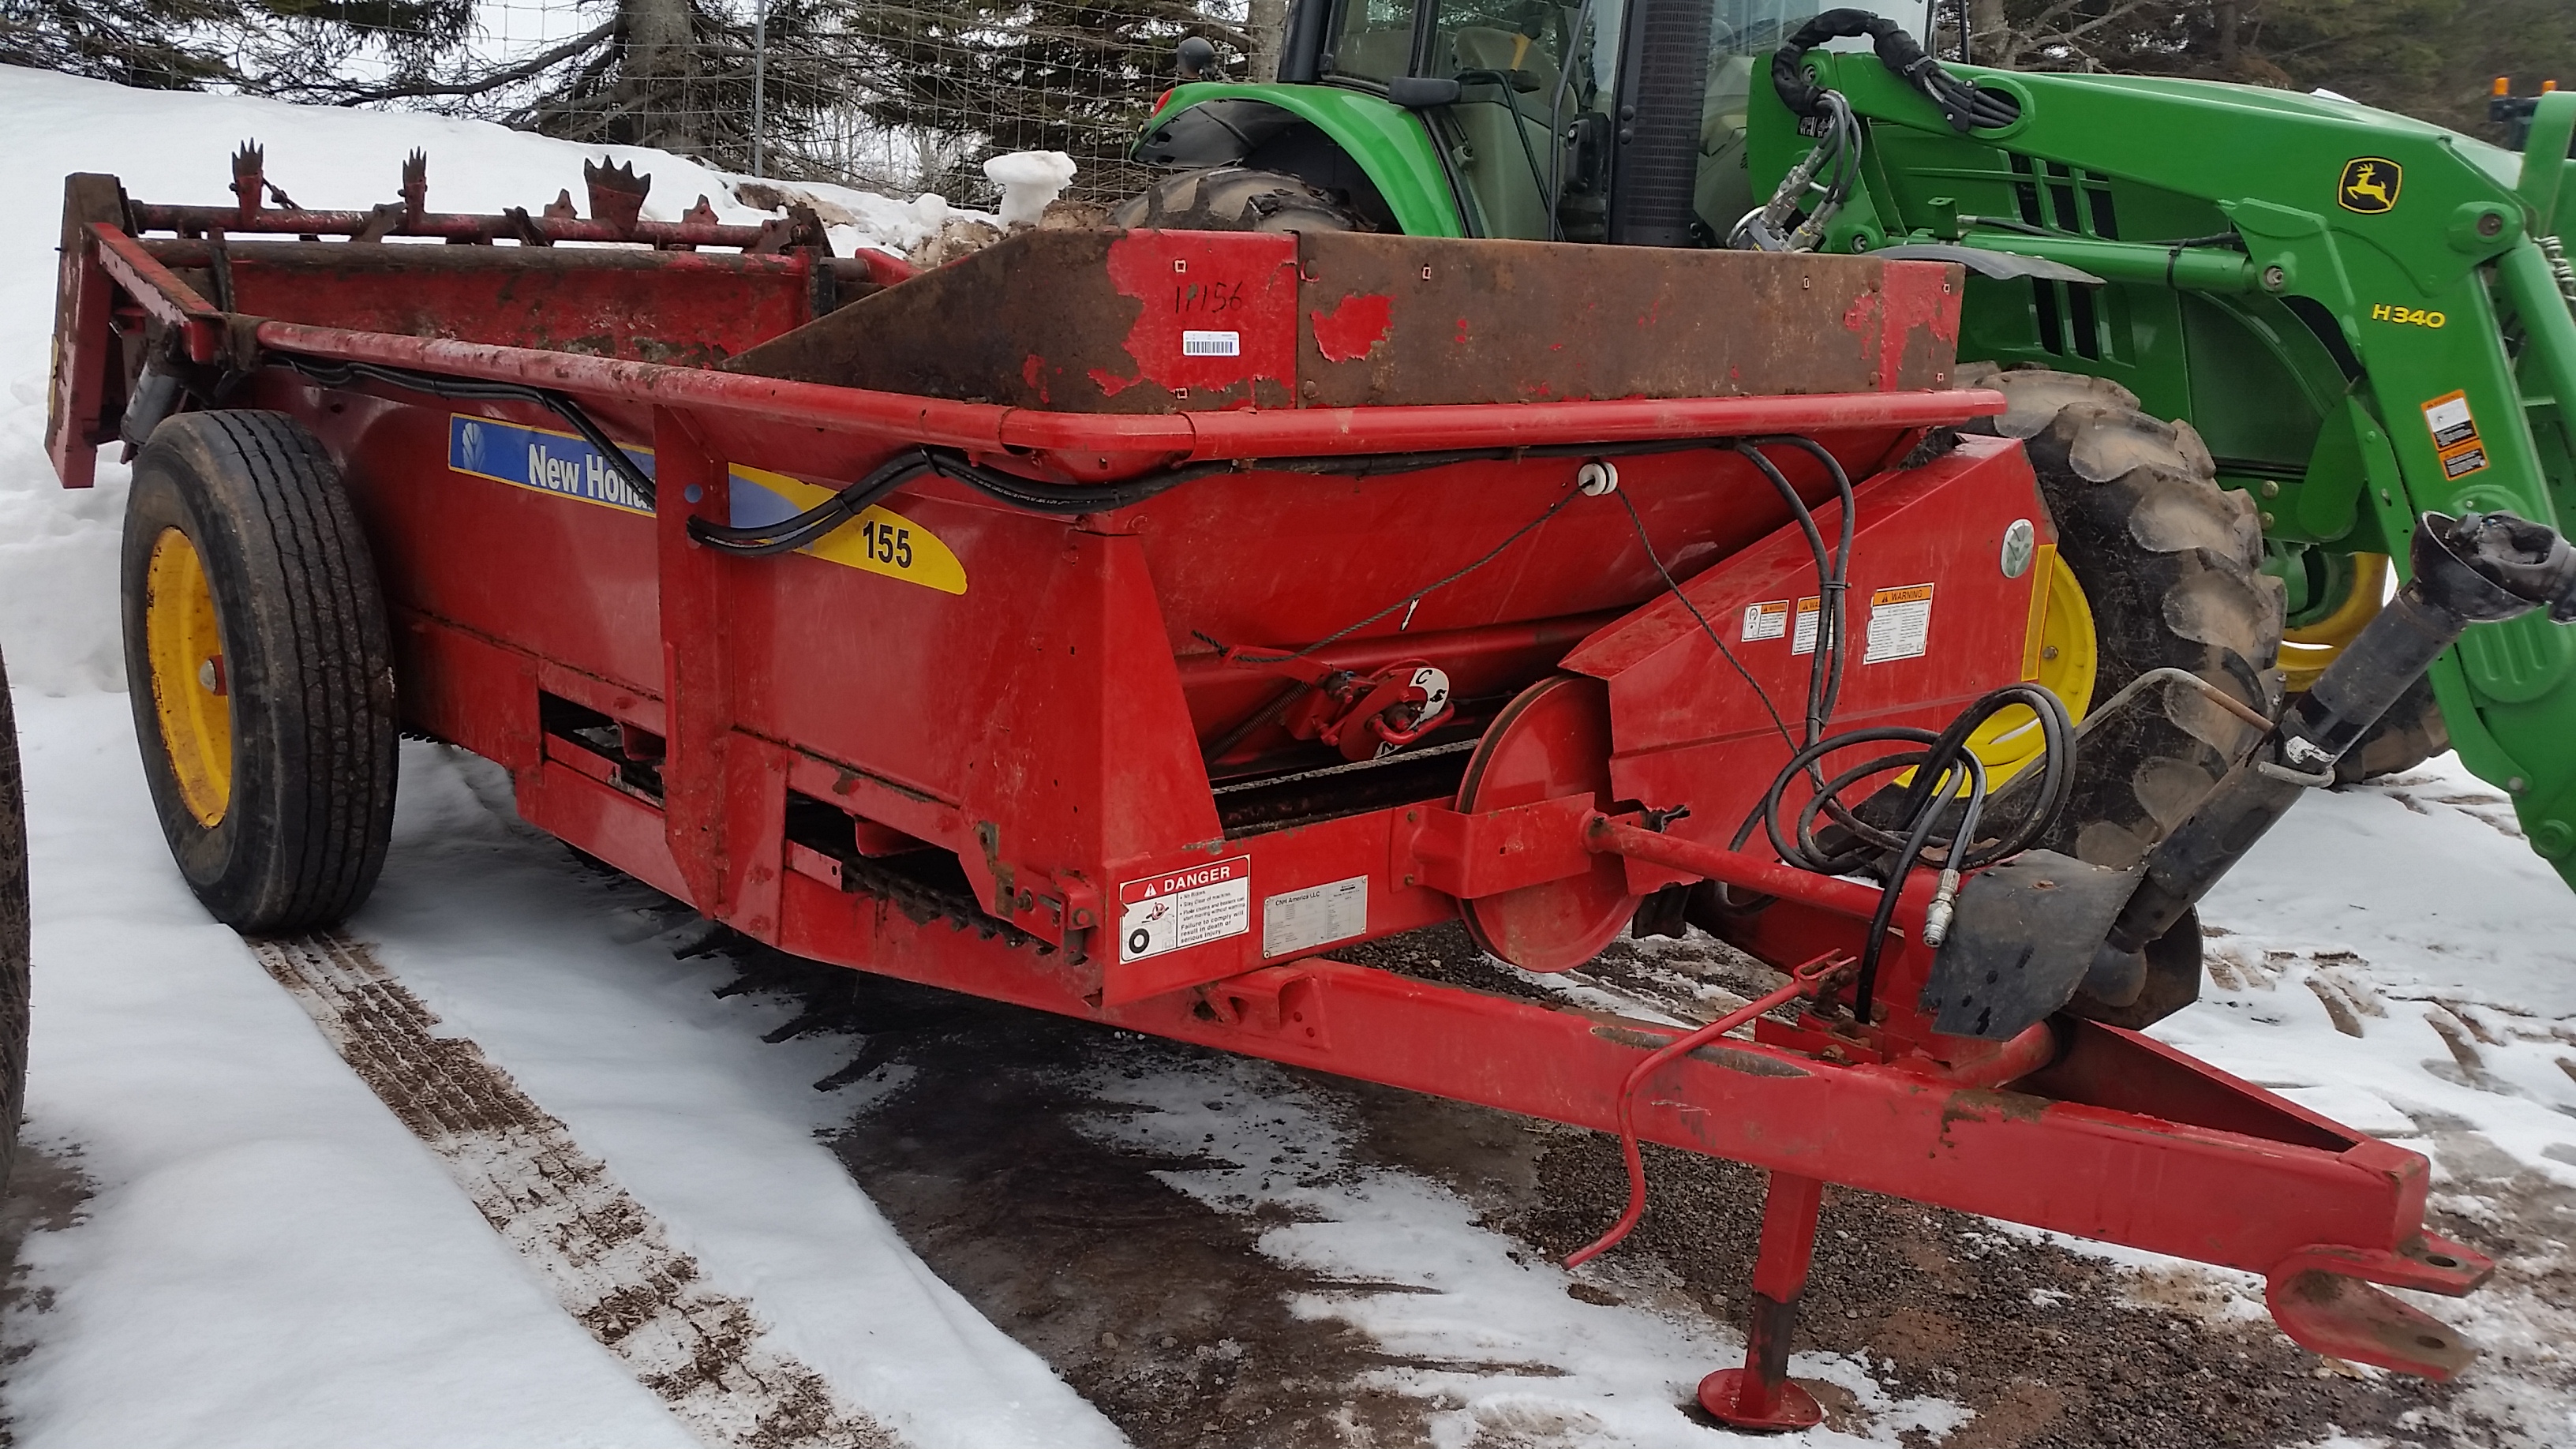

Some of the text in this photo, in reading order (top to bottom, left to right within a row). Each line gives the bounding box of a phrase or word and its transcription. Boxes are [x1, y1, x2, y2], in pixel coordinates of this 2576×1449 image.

[2372, 303, 2446, 328] H340
[529, 444, 580, 493] New
[863, 520, 912, 569] 155
[1891, 590, 1923, 601] WARNING
[1415, 669, 1433, 685] C
[1163, 866, 1230, 893] DANGER
[1288, 894, 1309, 903] America
[1181, 921, 1201, 930] Failure
[1181, 934, 1203, 943] serious
